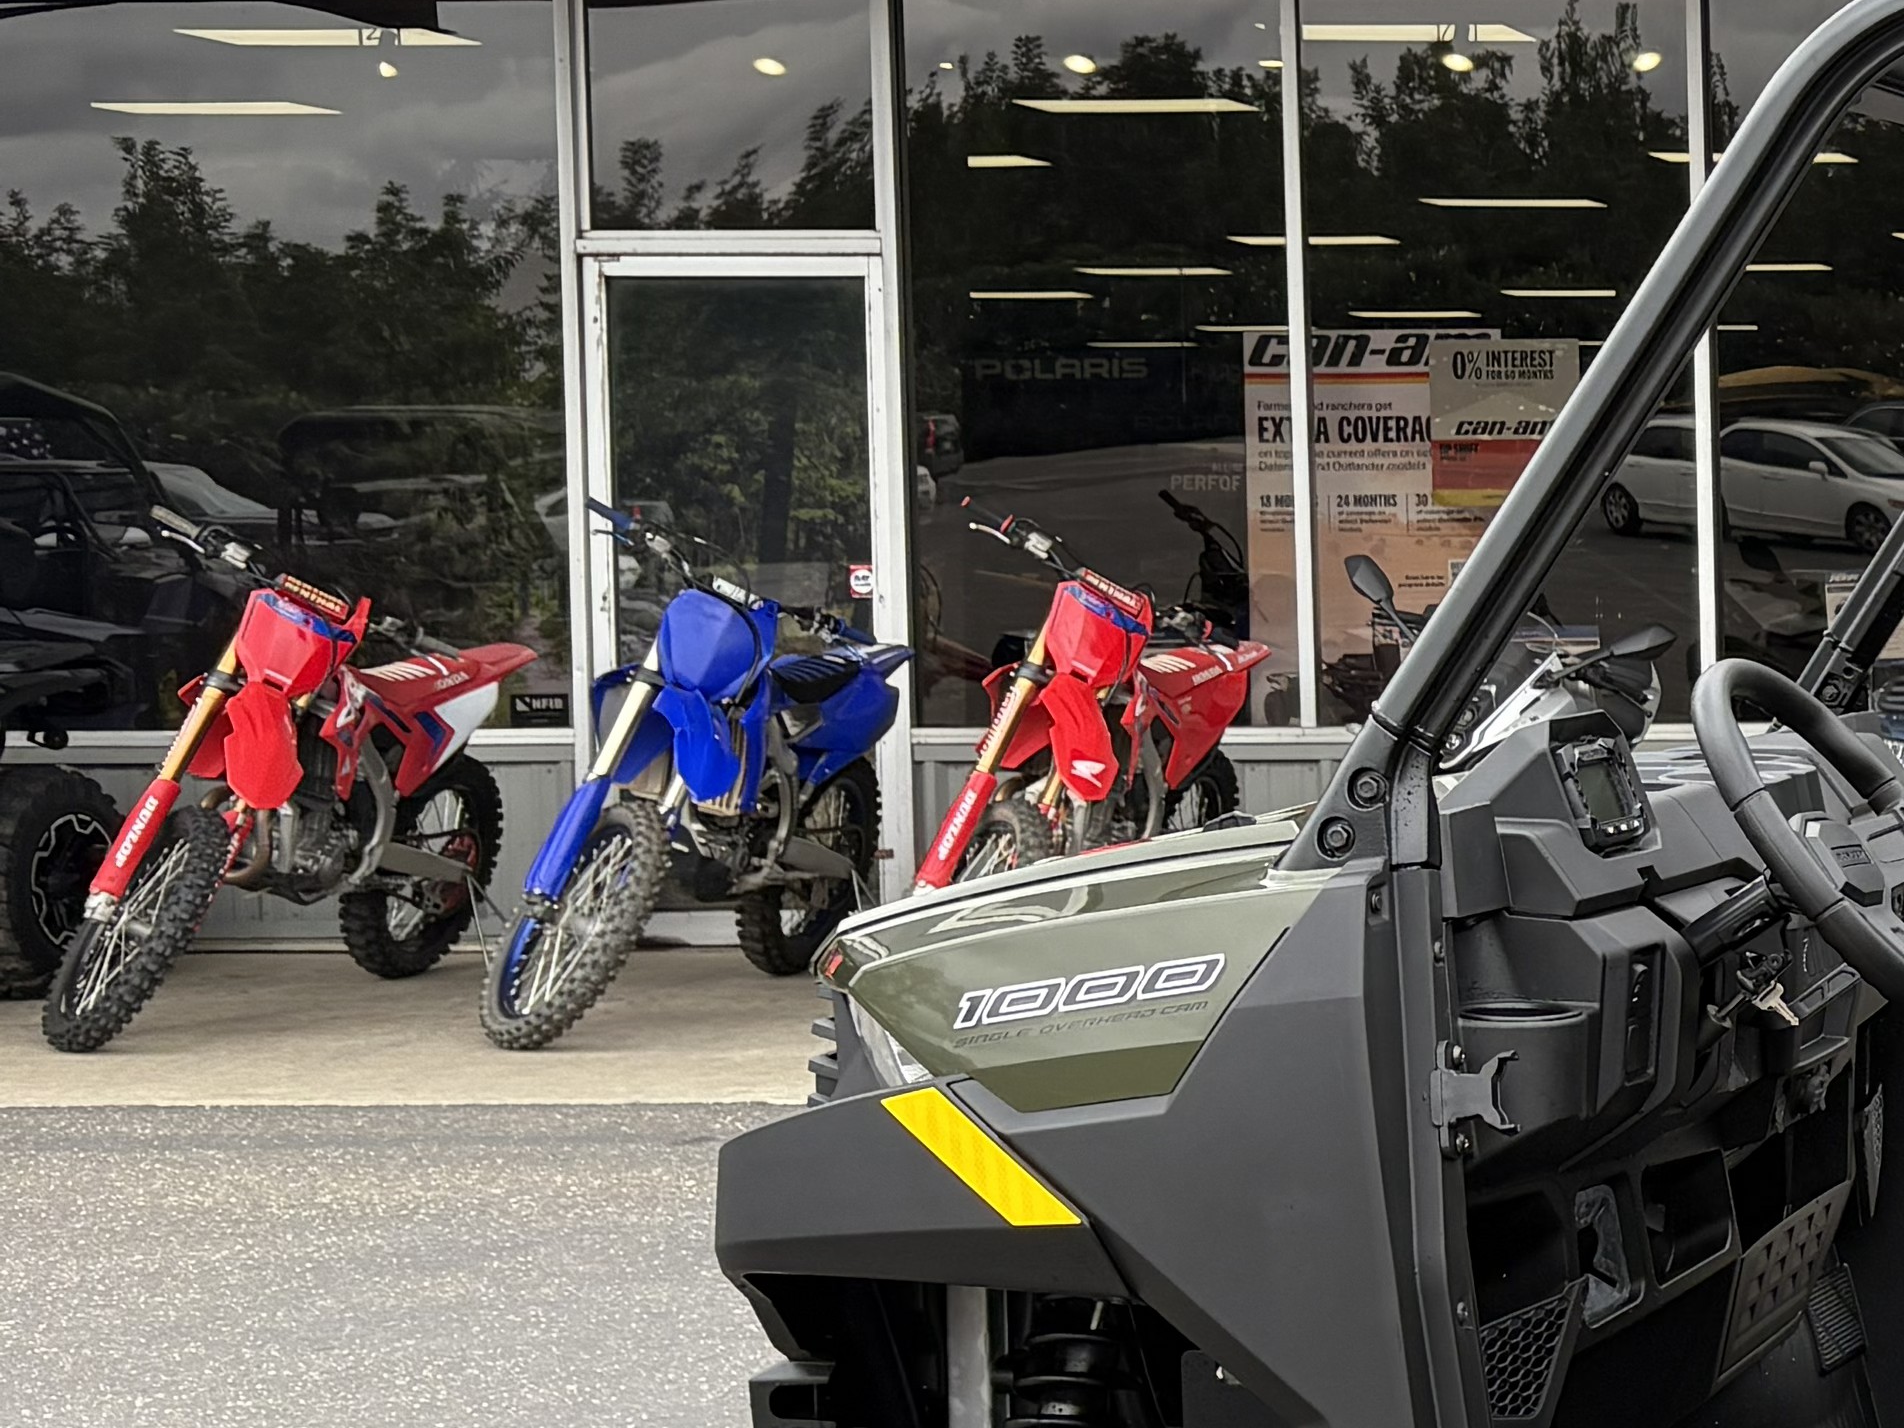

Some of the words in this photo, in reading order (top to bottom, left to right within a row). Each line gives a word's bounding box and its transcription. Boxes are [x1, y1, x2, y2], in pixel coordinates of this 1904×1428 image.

[974, 357, 1149, 380] POLARIS
[1452, 351, 1482, 380] 0%
[1486, 349, 1556, 369] INTEREST
[1486, 369, 1502, 380] FOR
[1505, 369, 1516, 380] 60
[1518, 369, 1554, 380] MONTHS
[1257, 416, 1330, 443] EXA
[1338, 415, 1431, 443] COVERA
[1353, 494, 1398, 508] MONTHS
[116, 794, 159, 869] DUNLOP
[938, 787, 978, 861] DUNLOP
[953, 953, 1226, 1030] 1000
[953, 1028, 1030, 1049] SINGLE
[1040, 1008, 1156, 1034] OVERHEAD
[1159, 1001, 1208, 1017] CAM
